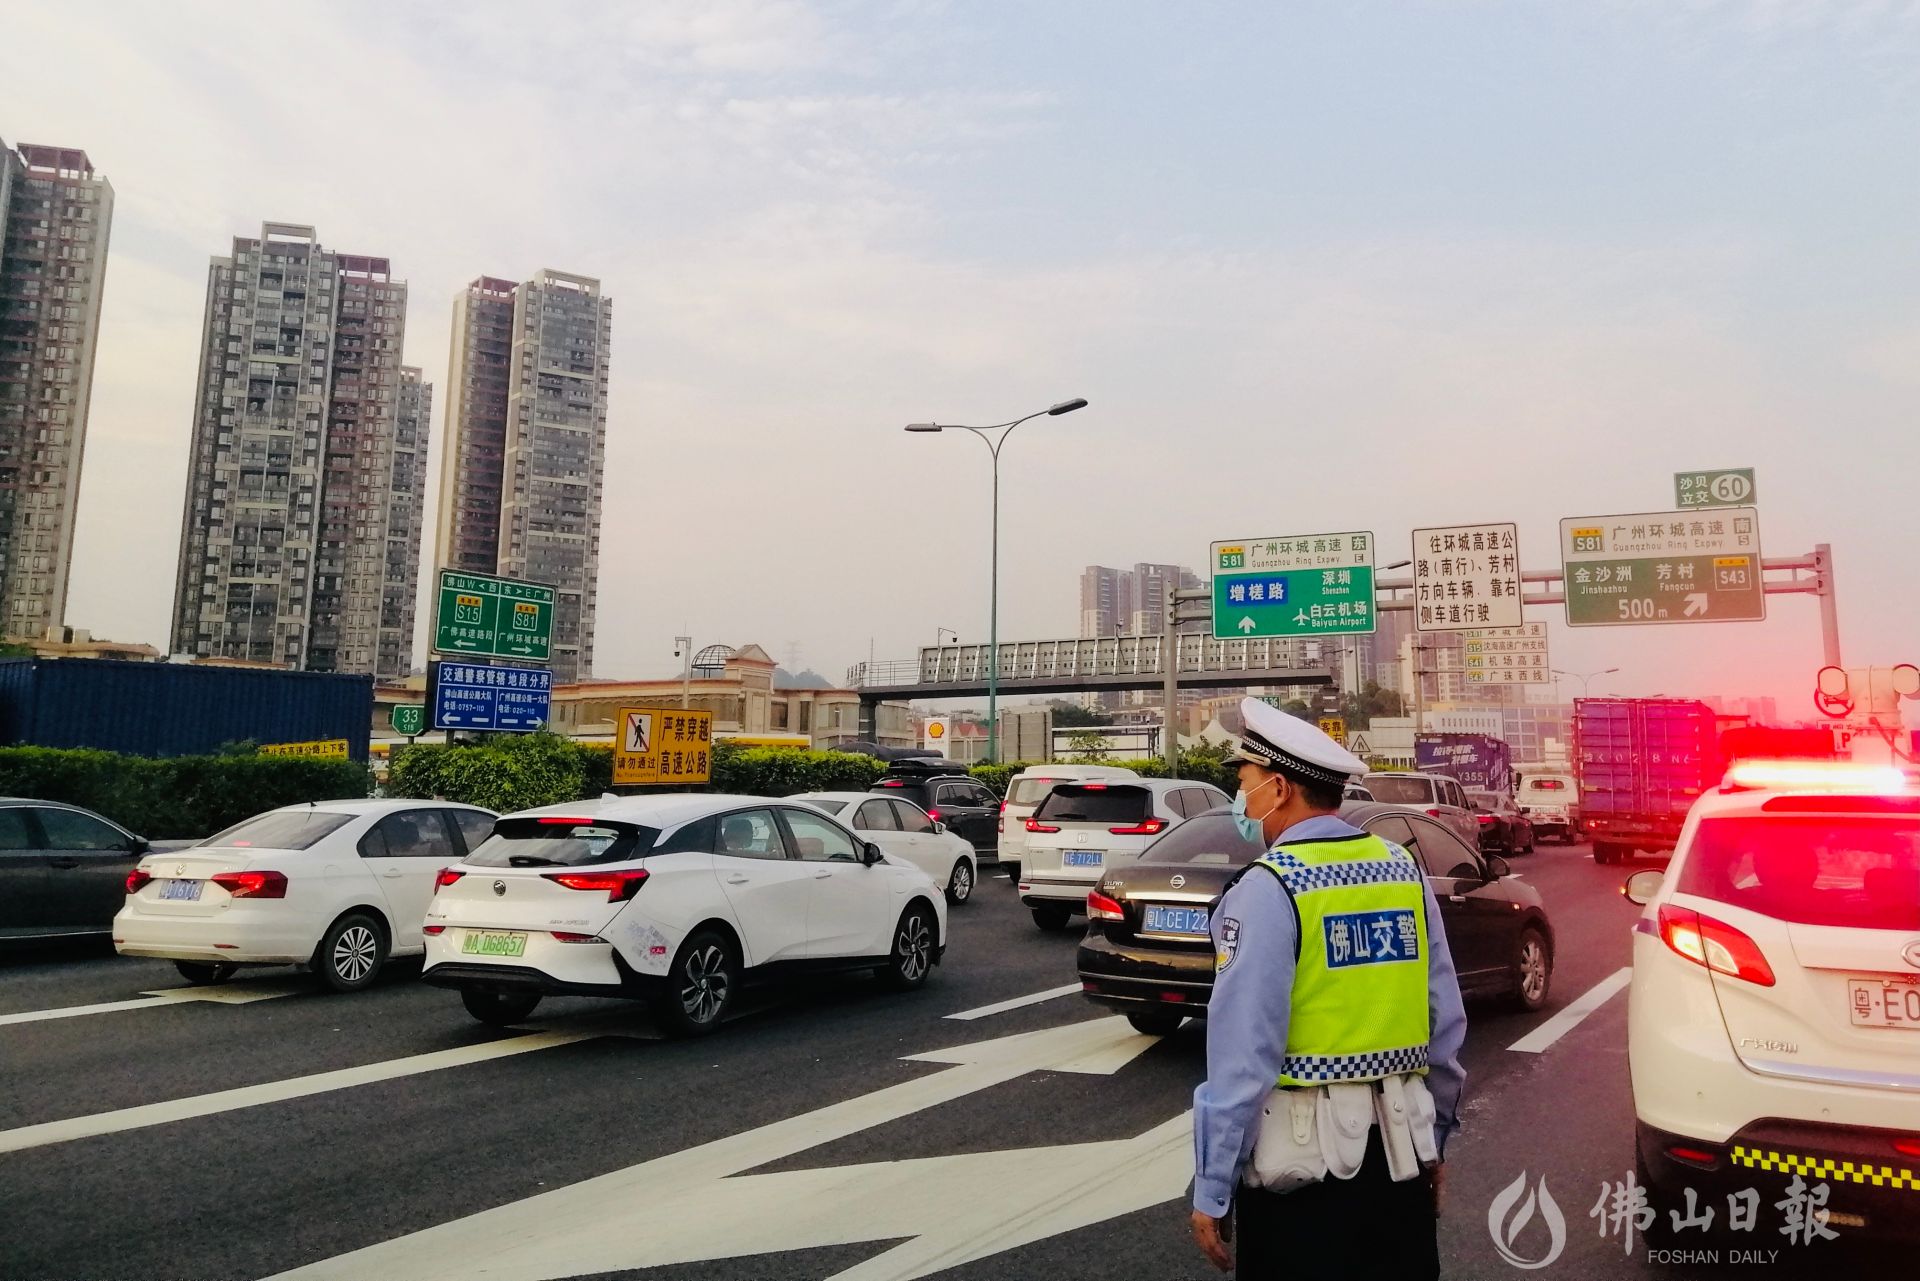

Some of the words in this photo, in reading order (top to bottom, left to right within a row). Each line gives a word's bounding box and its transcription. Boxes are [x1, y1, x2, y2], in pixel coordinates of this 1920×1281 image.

[1679, 475, 1708, 490] 沙贝
[1717, 477, 1743, 498] 60
[1681, 491, 1709, 505] 立交
[1612, 520, 1725, 540] 广州环城高速
[1251, 538, 1342, 557] 广州环城高速
[1352, 536, 1366, 550] 东
[1429, 530, 1513, 554] 往环城高速公
[1576, 536, 1601, 551] S81
[1613, 543, 1662, 552] Guangzhou
[1667, 541, 1688, 550] Ring
[1222, 555, 1242, 568] S81
[1252, 559, 1291, 568] Guangzhou
[1295, 557, 1312, 566] Ring
[1321, 570, 1351, 586] 深圳
[1574, 565, 1633, 583] 金沙洲
[1656, 562, 1695, 580] 芳村
[1719, 570, 1746, 585] S43
[1229, 582, 1284, 602] 增槎路
[1321, 586, 1350, 596] Shenzhen
[1580, 585, 1628, 595] Jinshazhou
[1659, 582, 1695, 593] Fangcun
[457, 605, 479, 621] S15
[1310, 600, 1367, 618] 白云机场
[1420, 602, 1490, 625] 侧车道行驶
[1618, 598, 1655, 619] 500
[1658, 608, 1668, 618] m
[515, 613, 535, 628] S81
[1311, 618, 1337, 629] Baiyun
[1339, 618, 1366, 628] Airport
[440, 626, 494, 641] 广佛高速路段
[498, 632, 549, 647] 广州环城高速
[1484, 641, 1545, 651] 沈海高速广州支线
[1488, 655, 1542, 666] 机场高速
[443, 666, 549, 689] 交通警察管辖地段分界
[1489, 670, 1543, 681] 广珠西线
[402, 709, 418, 723] 33
[662, 716, 709, 742] 严禁穿越
[617, 756, 656, 770] 请勿通过
[661, 750, 707, 776] 高速公路
[1457, 771, 1483, 782] Y355
[1329, 913, 1417, 963] 佛山交警
